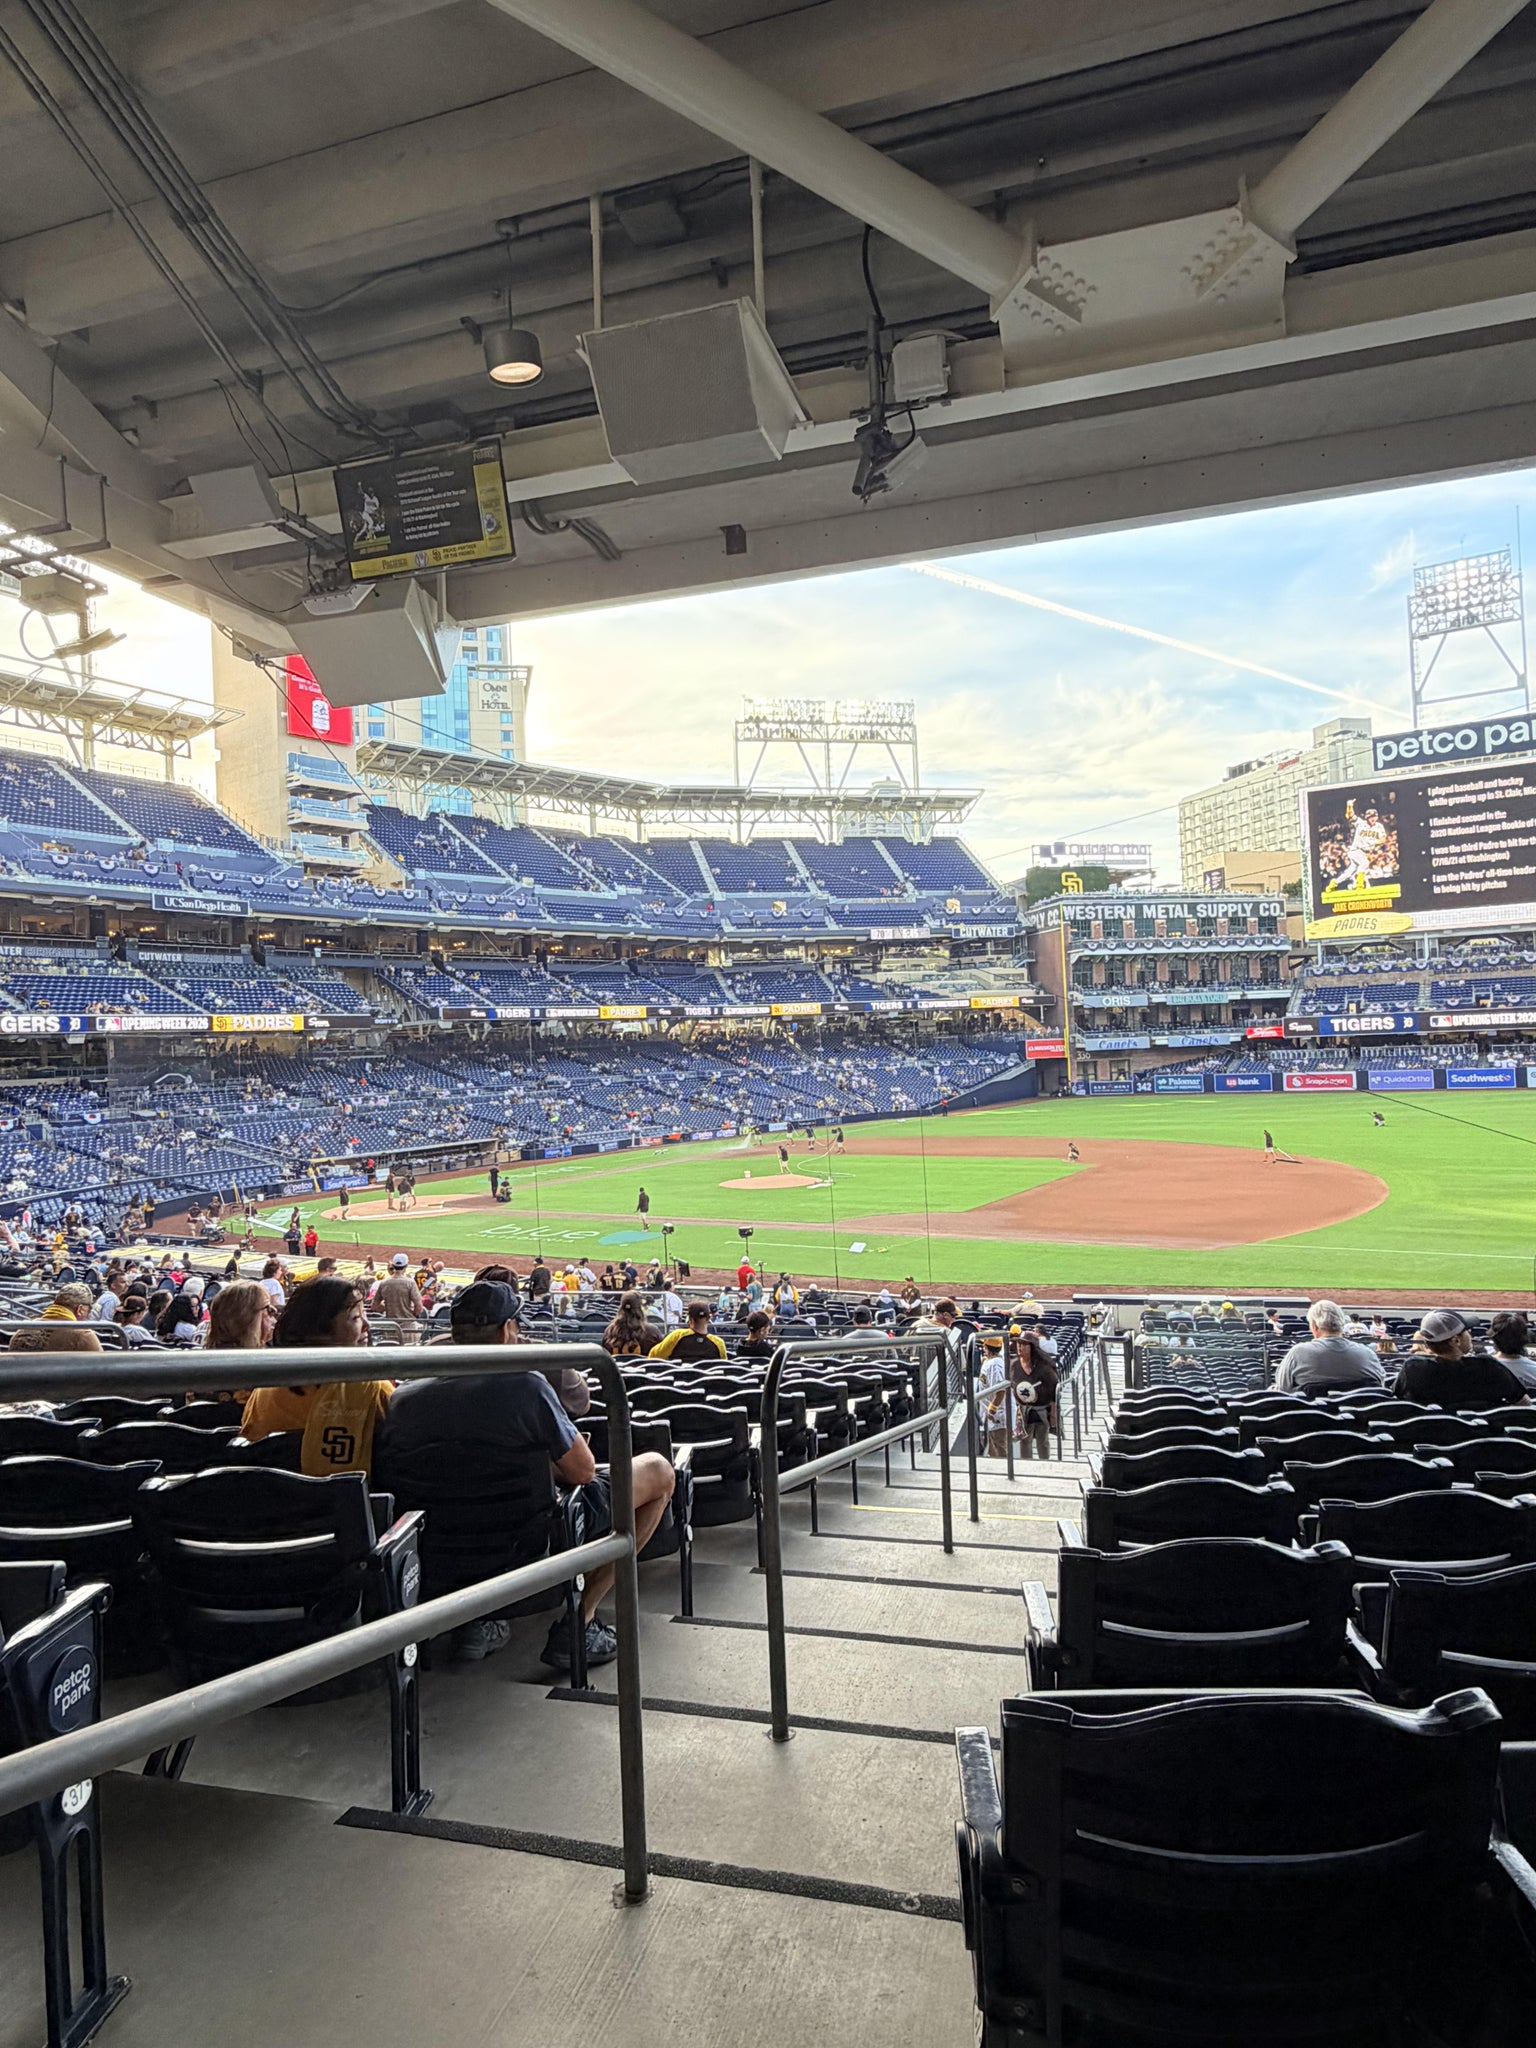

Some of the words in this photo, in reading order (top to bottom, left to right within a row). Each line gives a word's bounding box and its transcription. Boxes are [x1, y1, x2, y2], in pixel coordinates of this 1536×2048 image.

[1376, 729, 1478, 768] petco
[1432, 785, 1454, 797] played
[1454, 781, 1484, 792] baseball
[1484, 780, 1497, 788] and
[1498, 777, 1524, 787] hockey
[1448, 794, 1477, 806] growing
[1477, 793, 1486, 802] up
[1487, 792, 1494, 800] in
[1433, 816, 1461, 826] finished
[1462, 812, 1486, 823] second
[1494, 810, 1507, 819] the
[1448, 825, 1476, 836] National
[1476, 823, 1501, 834] League
[1502, 820, 1526, 830] Rookie
[1526, 818, 1534, 827] of
[1435, 846, 1448, 854] was
[1449, 845, 1460, 853] the
[1461, 842, 1478, 852] third
[1479, 841, 1499, 850] Padre
[1500, 840, 1507, 848] to
[1508, 838, 1518, 847] hit
[1518, 837, 1529, 846] for
[1467, 851, 1510, 863] Washington)
[1436, 874, 1447, 882] am
[1448, 873, 1459, 881] the
[1513, 865, 1536, 875] leader
[1433, 886, 1441, 894] in
[1441, 884, 1460, 894] being
[1461, 883, 1471, 891] hit
[1472, 882, 1480, 892] by
[1481, 881, 1507, 891] pitches
[164, 897, 177, 907] UC
[178, 898, 194, 908] San
[194, 900, 216, 912] Diego
[217, 901, 241, 912] Health
[1063, 904, 1136, 920] WESTERN
[1143, 904, 1192, 919] METAL
[1196, 903, 1253, 918] SUPPLY
[1259, 902, 1284, 917] CO.
[960, 927, 1007, 937] CUTWATER
[1334, 918, 1377, 932] PADRES
[139, 952, 182, 961] CUTWATER
[783, 1005, 817, 1013] PADRES
[871, 1002, 903, 1010] TIGERS
[982, 998, 1013, 1006] PADRES
[1102, 997, 1131, 1007] ORIS
[495, 1009, 530, 1018] TIGERS
[611, 1007, 641, 1016] PADRES
[122, 1017, 163, 1030] OPENING
[163, 1017, 187, 1030] WEEK
[187, 1017, 208, 1030] 2026
[232, 1016, 294, 1030] PADRES
[1330, 1017, 1395, 1032] TIGERS
[1452, 1014, 1490, 1026] OPENING
[1490, 1013, 1516, 1024] WEEK
[1305, 1077, 1347, 1086] Snapdragon
[1383, 1075, 1430, 1084] QuidelOrtho
[1451, 1073, 1504, 1083] Southwest
[1137, 1082, 1151, 1092] 342
[479, 1223, 600, 1238] blue
[321, 1426, 355, 1464] SD
[404, 1564, 418, 1588] petco
[406, 1574, 419, 1597] park
[54, 1663, 91, 1706] petco
[61, 1678, 91, 1716] park
